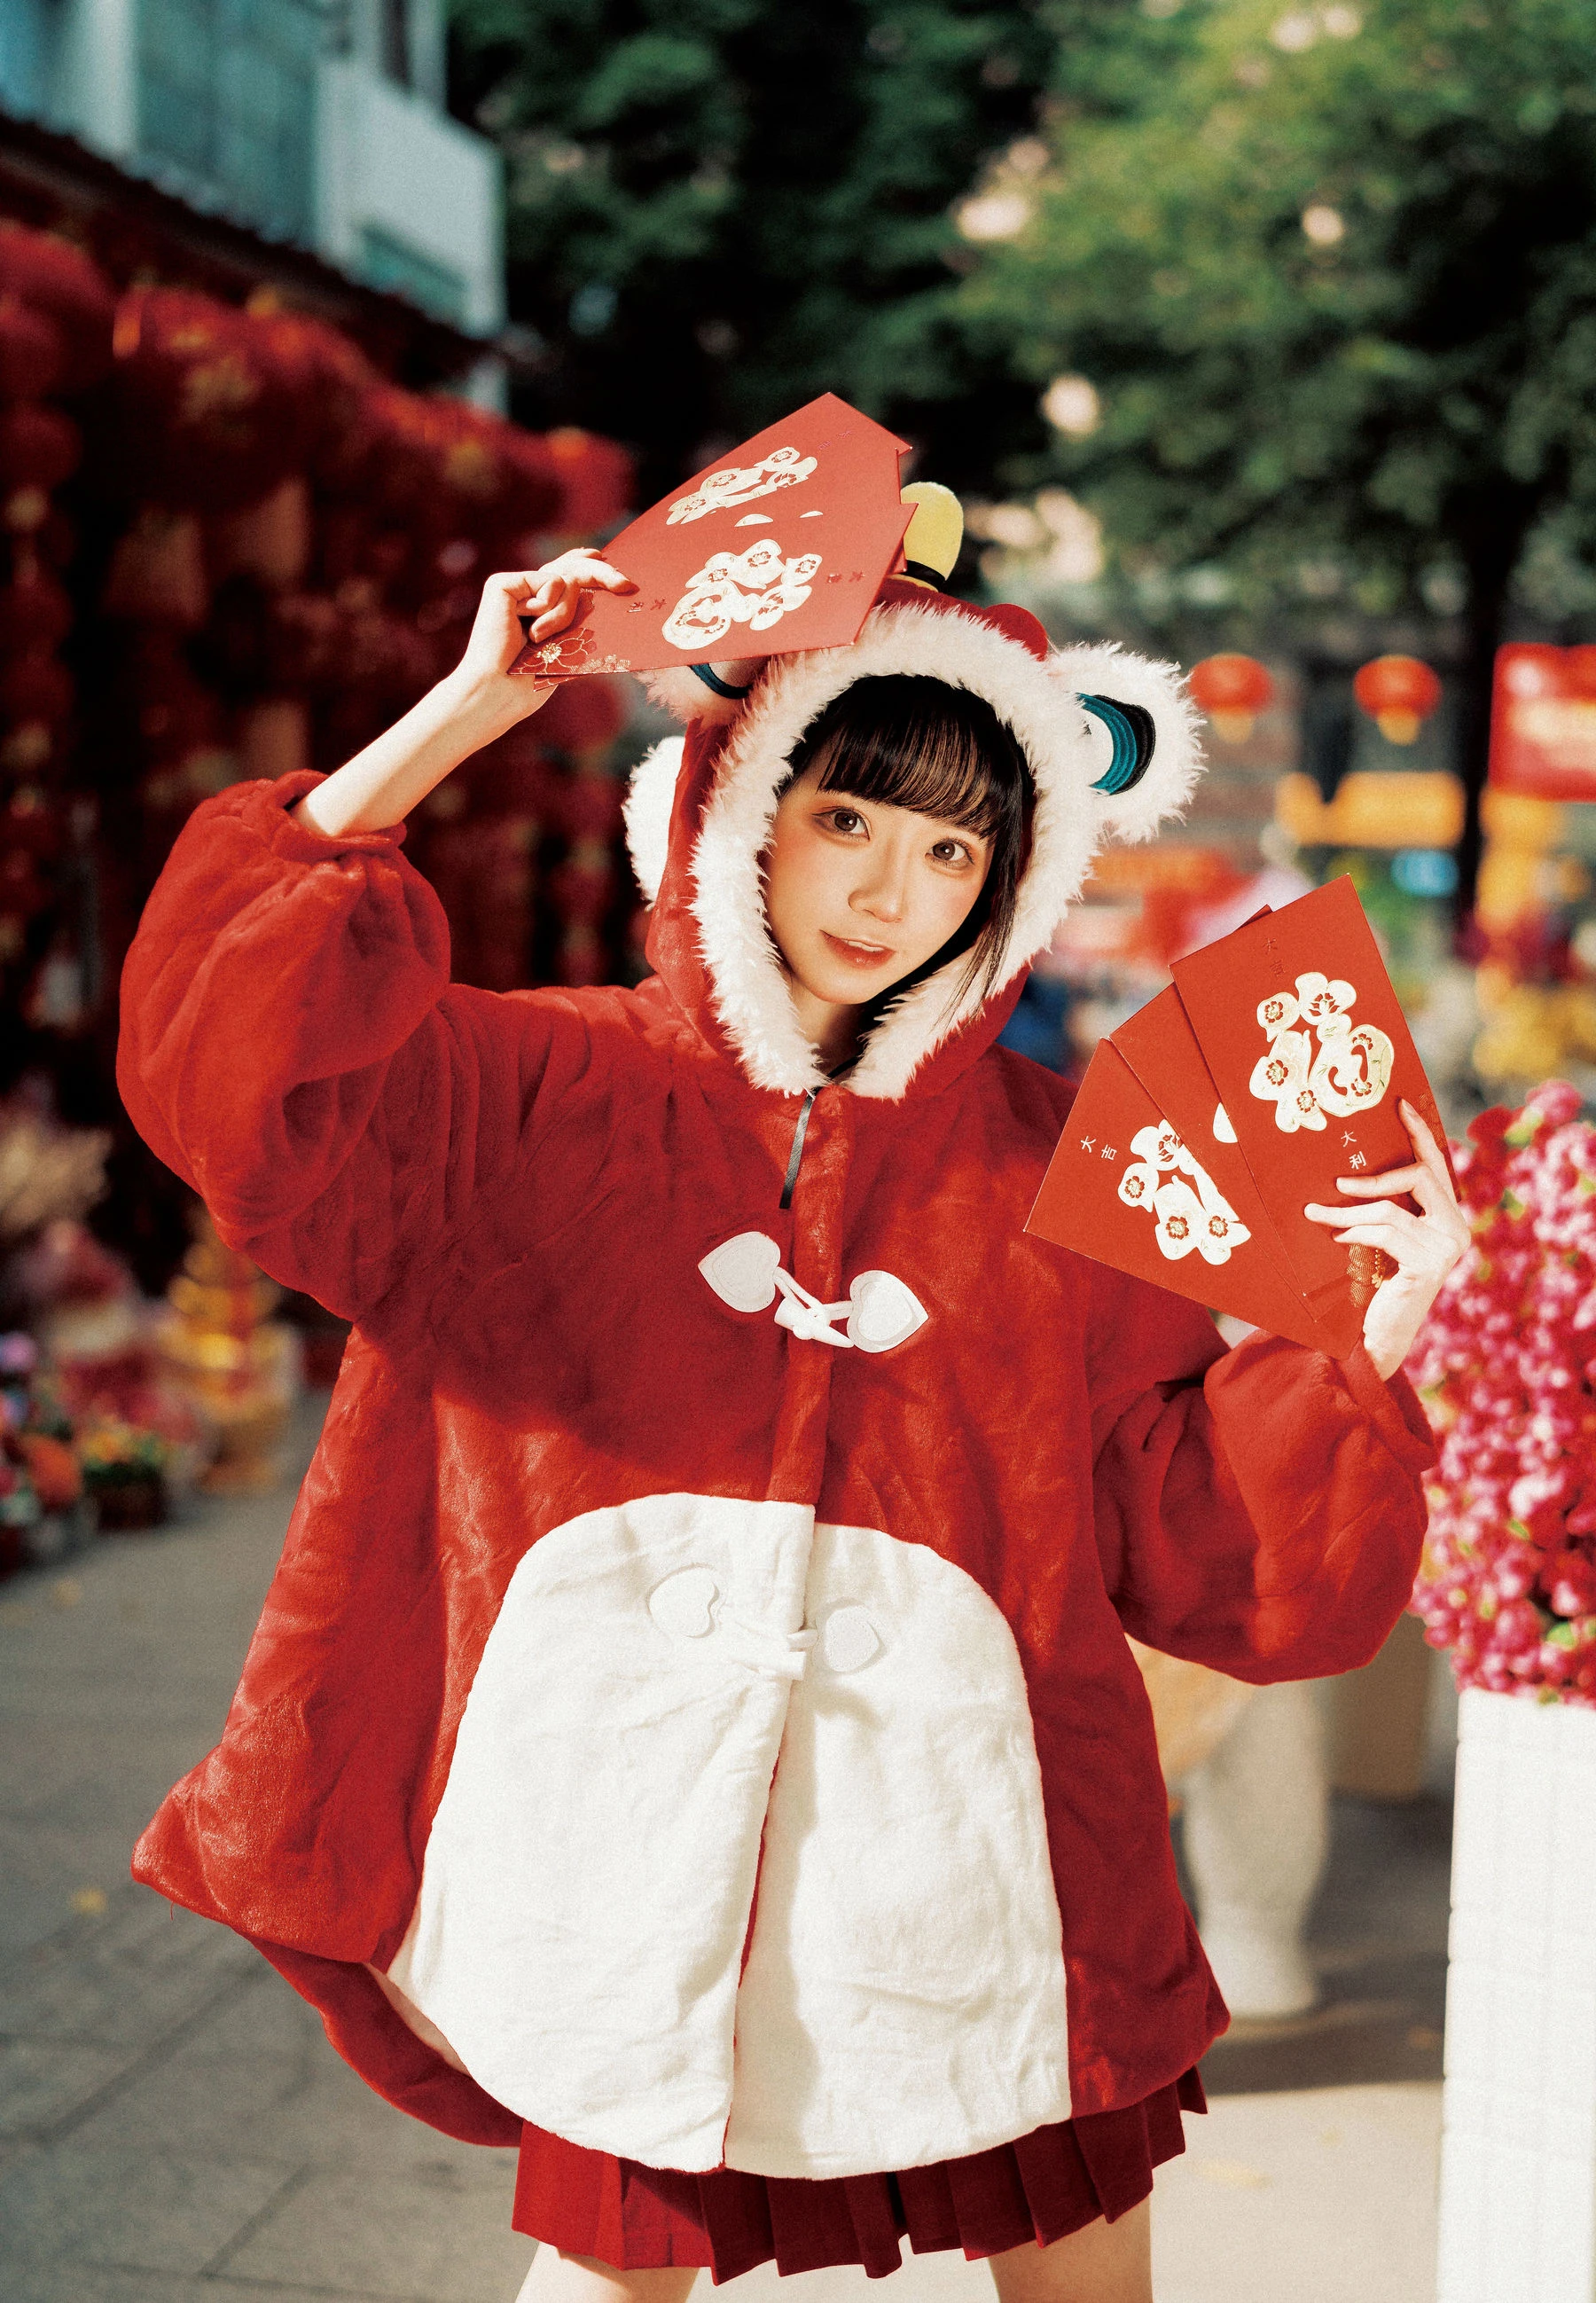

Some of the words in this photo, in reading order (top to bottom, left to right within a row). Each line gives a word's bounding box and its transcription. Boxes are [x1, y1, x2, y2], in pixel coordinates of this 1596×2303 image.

[661, 538, 823, 650] 福
[1248, 971, 1395, 1133] 福
[1080, 1135, 1117, 1161] 大吉
[1341, 1131, 1366, 1170] 大利
